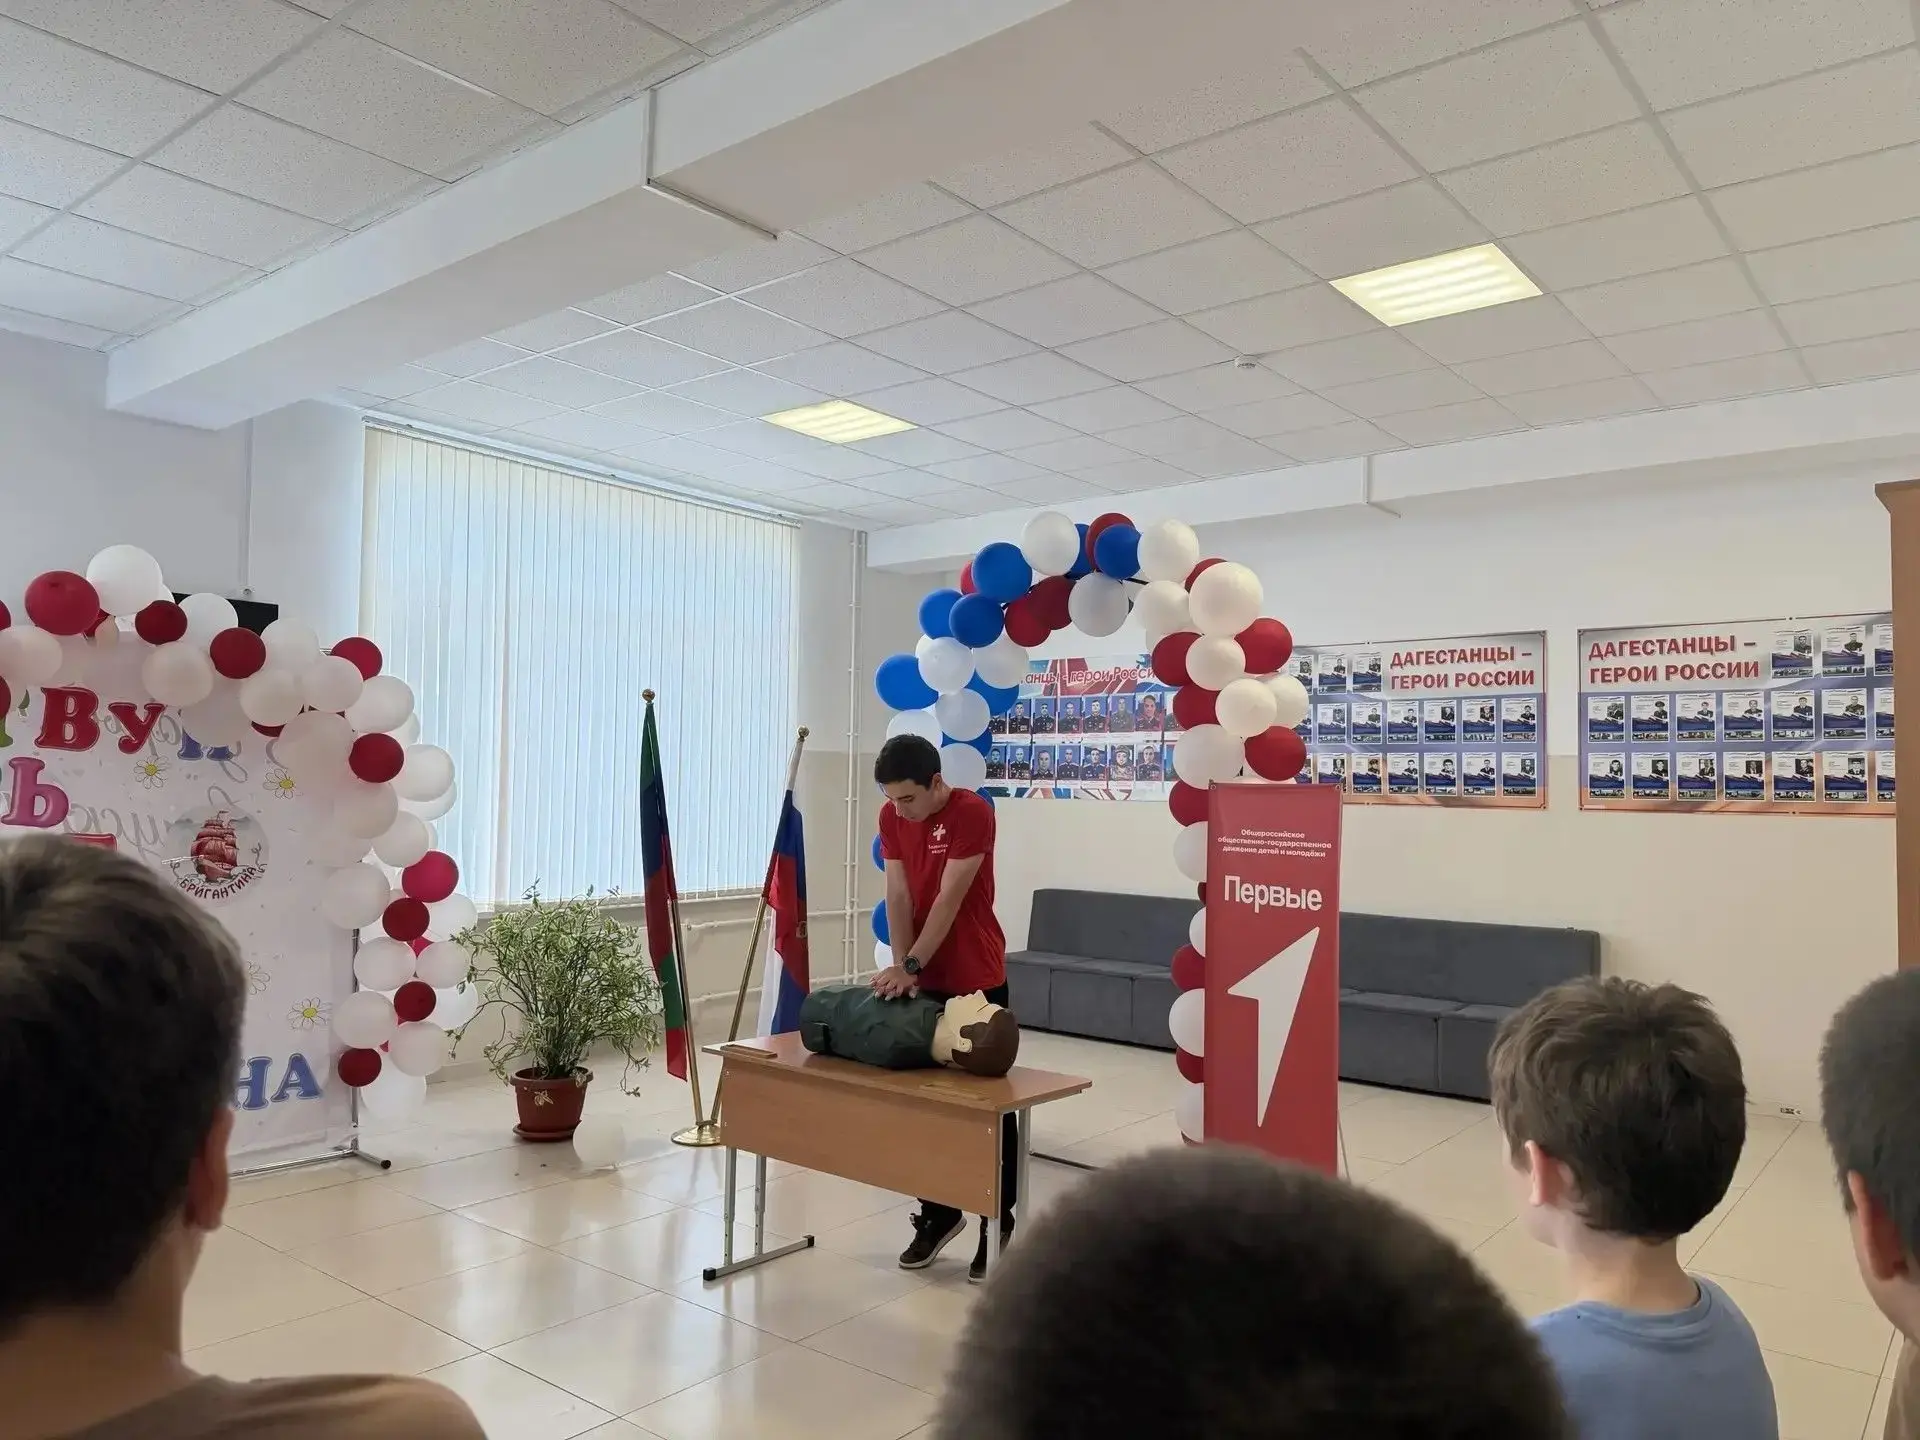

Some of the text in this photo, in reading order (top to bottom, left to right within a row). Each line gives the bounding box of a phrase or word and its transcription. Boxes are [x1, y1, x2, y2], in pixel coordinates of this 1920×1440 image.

[1390, 646, 1514, 669] ДАГЕСТАНЦЫ
[1590, 635, 1735, 661] ДАГЕСТАНЦЫ
[1068, 670, 1110, 685] герои
[1391, 670, 1534, 690] ГЕРОИ РОССИИ
[1590, 661, 1759, 684] ГЕРОИ РОССИИ
[1217, 836, 1332, 849] общественно-государственное
[1240, 829, 1305, 839] Общероссийское
[1222, 845, 1258, 854] движение
[1258, 847, 1280, 855] детей
[179, 866, 257, 900] БРИГАНТИНА
[1224, 874, 1323, 914] Первые
